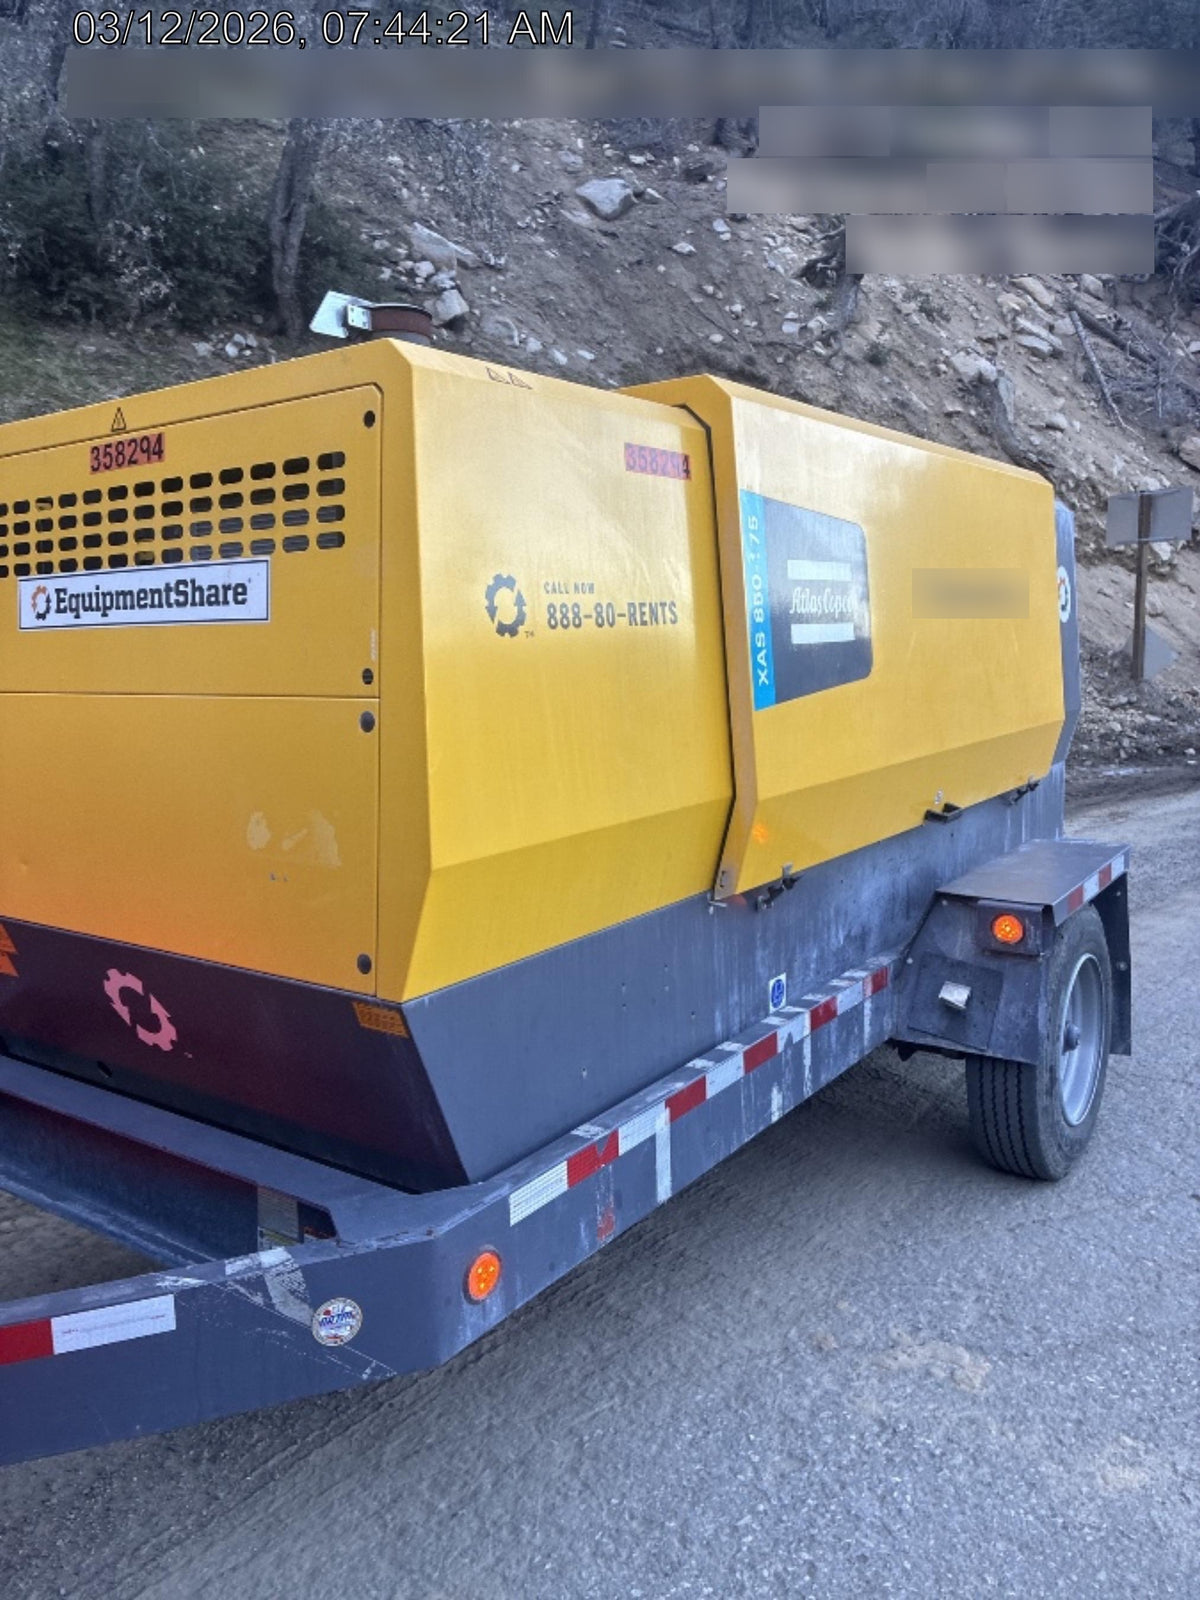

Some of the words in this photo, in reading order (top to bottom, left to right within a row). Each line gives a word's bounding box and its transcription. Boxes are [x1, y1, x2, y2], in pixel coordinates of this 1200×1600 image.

[90, 433, 164, 474] 358294
[625, 444, 690, 479] 358294
[54, 578, 247, 618] EquipmentShare
[543, 581, 570, 595] CALL
[573, 581, 595, 594] NOW
[789, 586, 822, 617] Atlas
[546, 601, 679, 630] 888-80-RENTS
[753, 634, 769, 686] XAS
